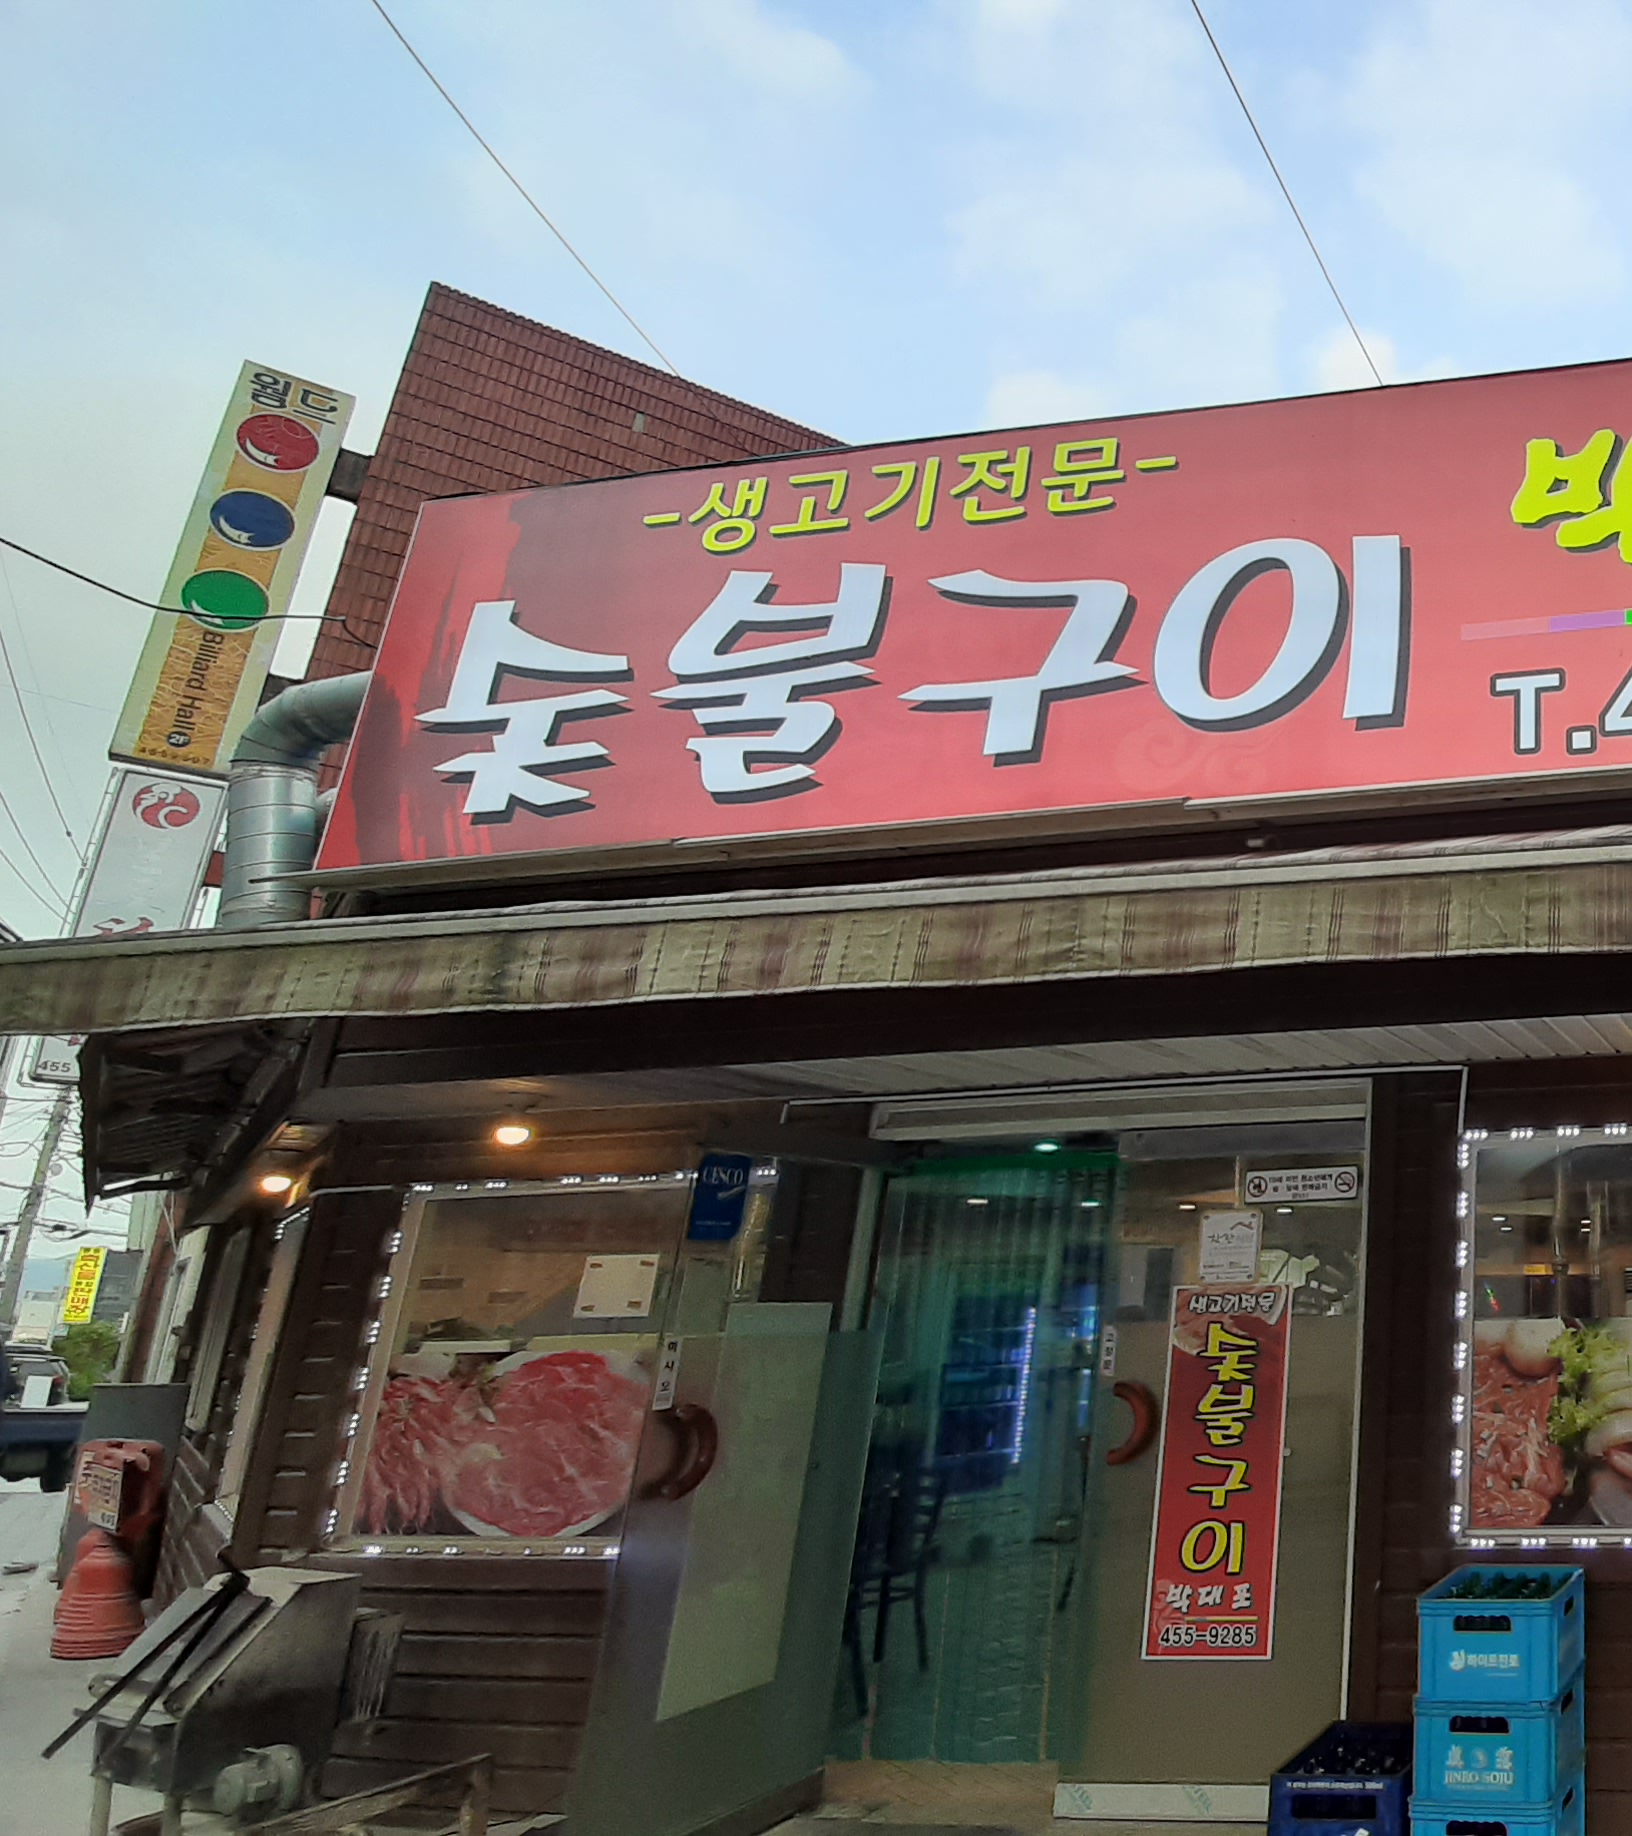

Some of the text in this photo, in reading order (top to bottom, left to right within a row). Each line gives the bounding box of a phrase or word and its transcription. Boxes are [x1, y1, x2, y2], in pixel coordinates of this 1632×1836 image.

[185, 630, 225, 693] Billiard
[412, 534, 1408, 822] 숯불구이
[172, 694, 201, 733] Hall
[702, 1165, 744, 1184] CESCO
[1166, 1582, 1254, 1614] 박대포
[1158, 1624, 1257, 1648] 455-9285
